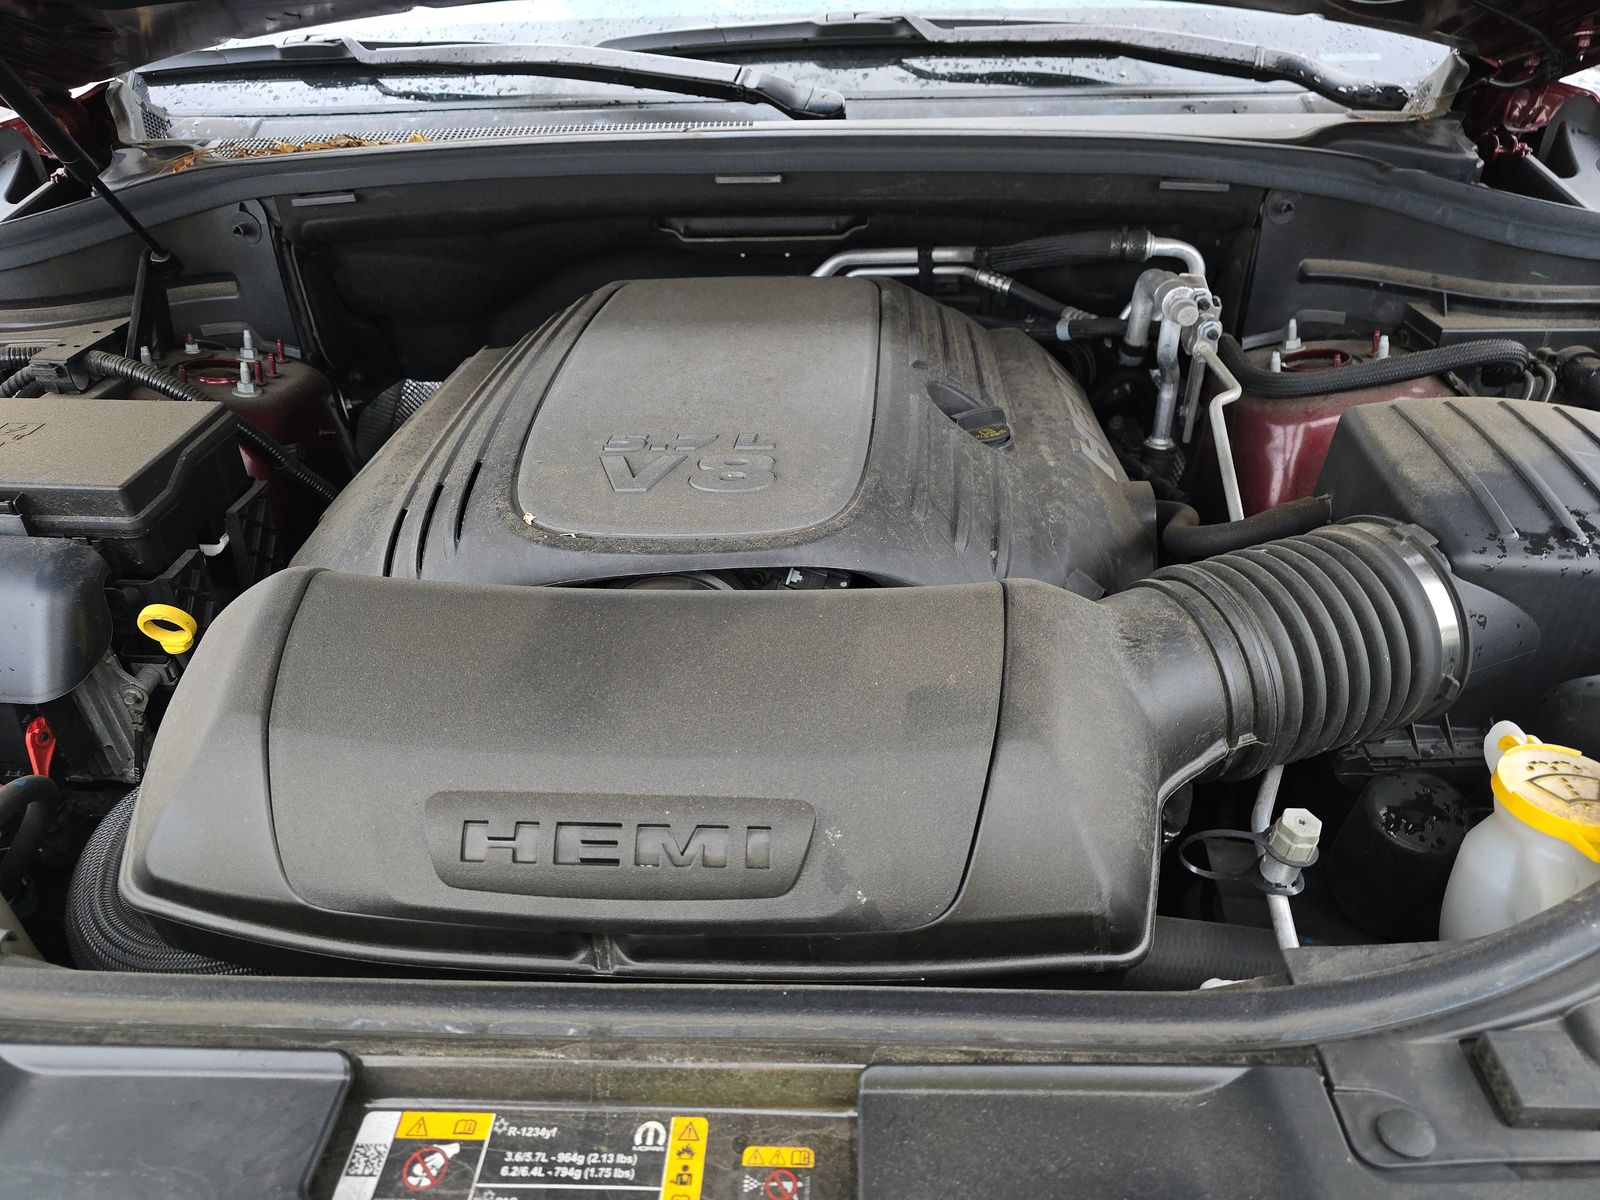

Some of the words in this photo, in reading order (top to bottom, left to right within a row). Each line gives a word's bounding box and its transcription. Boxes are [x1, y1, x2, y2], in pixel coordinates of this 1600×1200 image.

[599, 455, 777, 493] V8
[460, 819, 773, 870] HEMI
[507, 1127, 558, 1139] R-1234yf
[503, 1151, 549, 1163] 3.6/5.7L
[557, 1152, 586, 1165] 964g
[587, 1152, 614, 1165] (2.13
[616, 1153, 638, 1166] lbs)
[500, 1165, 546, 1177] 6.2/6.4L
[554, 1166, 582, 1180] 794g
[583, 1167, 613, 1180] (1.75
[613, 1167, 635, 1180] lbs)
